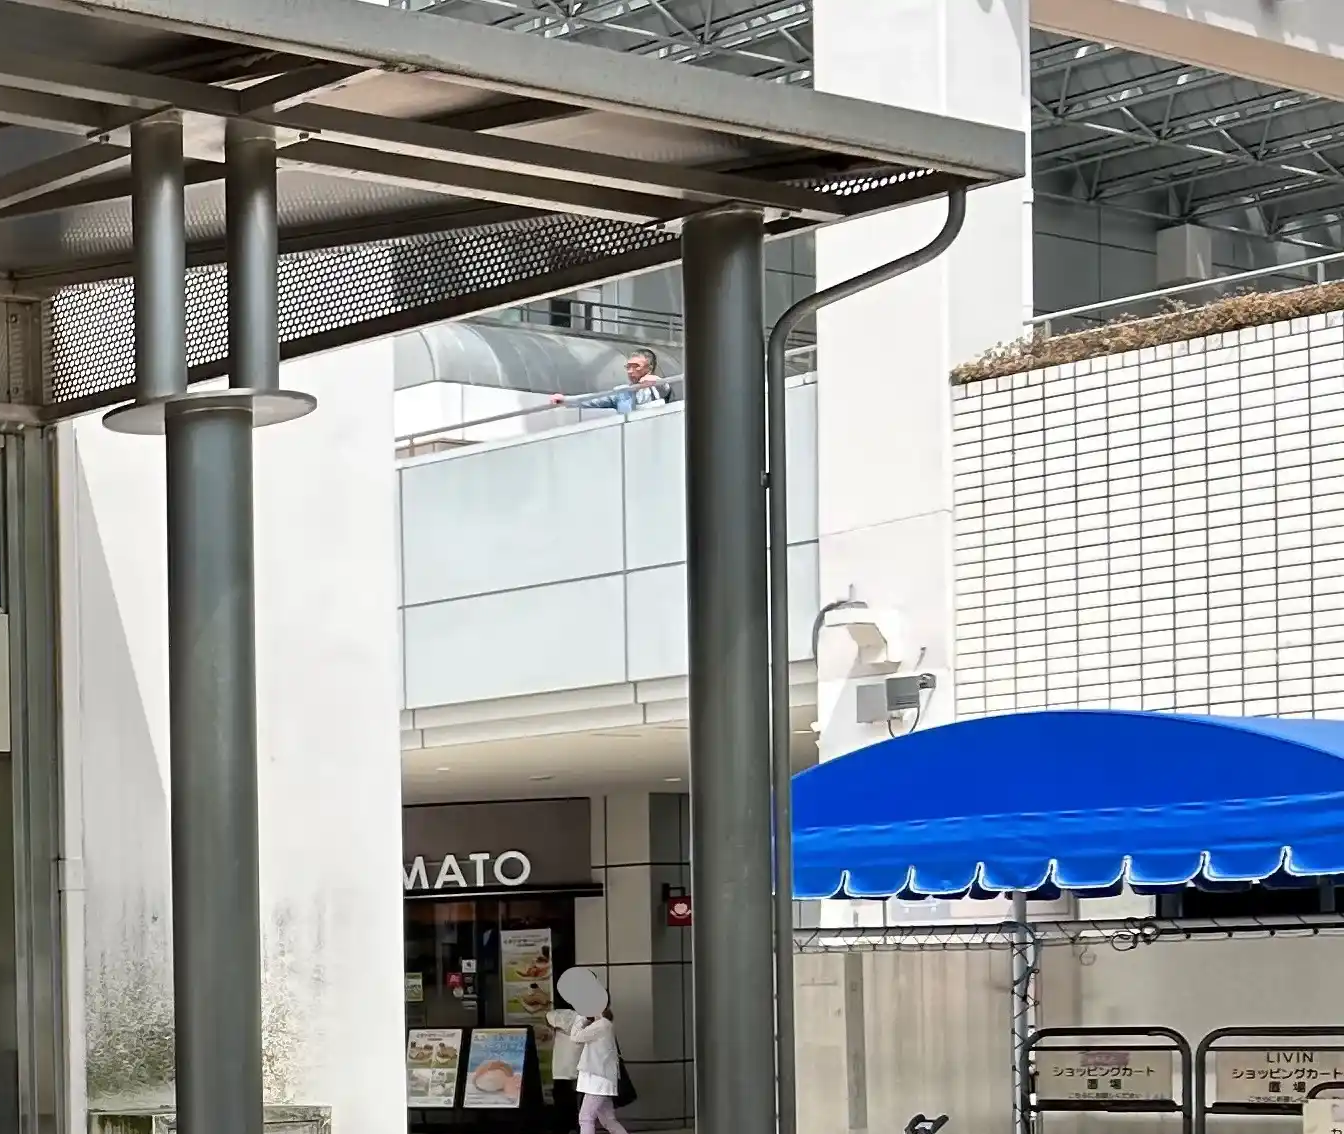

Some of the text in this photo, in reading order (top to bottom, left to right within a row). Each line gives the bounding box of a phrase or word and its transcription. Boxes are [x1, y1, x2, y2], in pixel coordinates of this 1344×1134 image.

[1267, 1051, 1315, 1064] LIVIN
[1052, 1065, 1156, 1078] ショッピングカート
[1231, 1068, 1344, 1080] ショッピングカート
